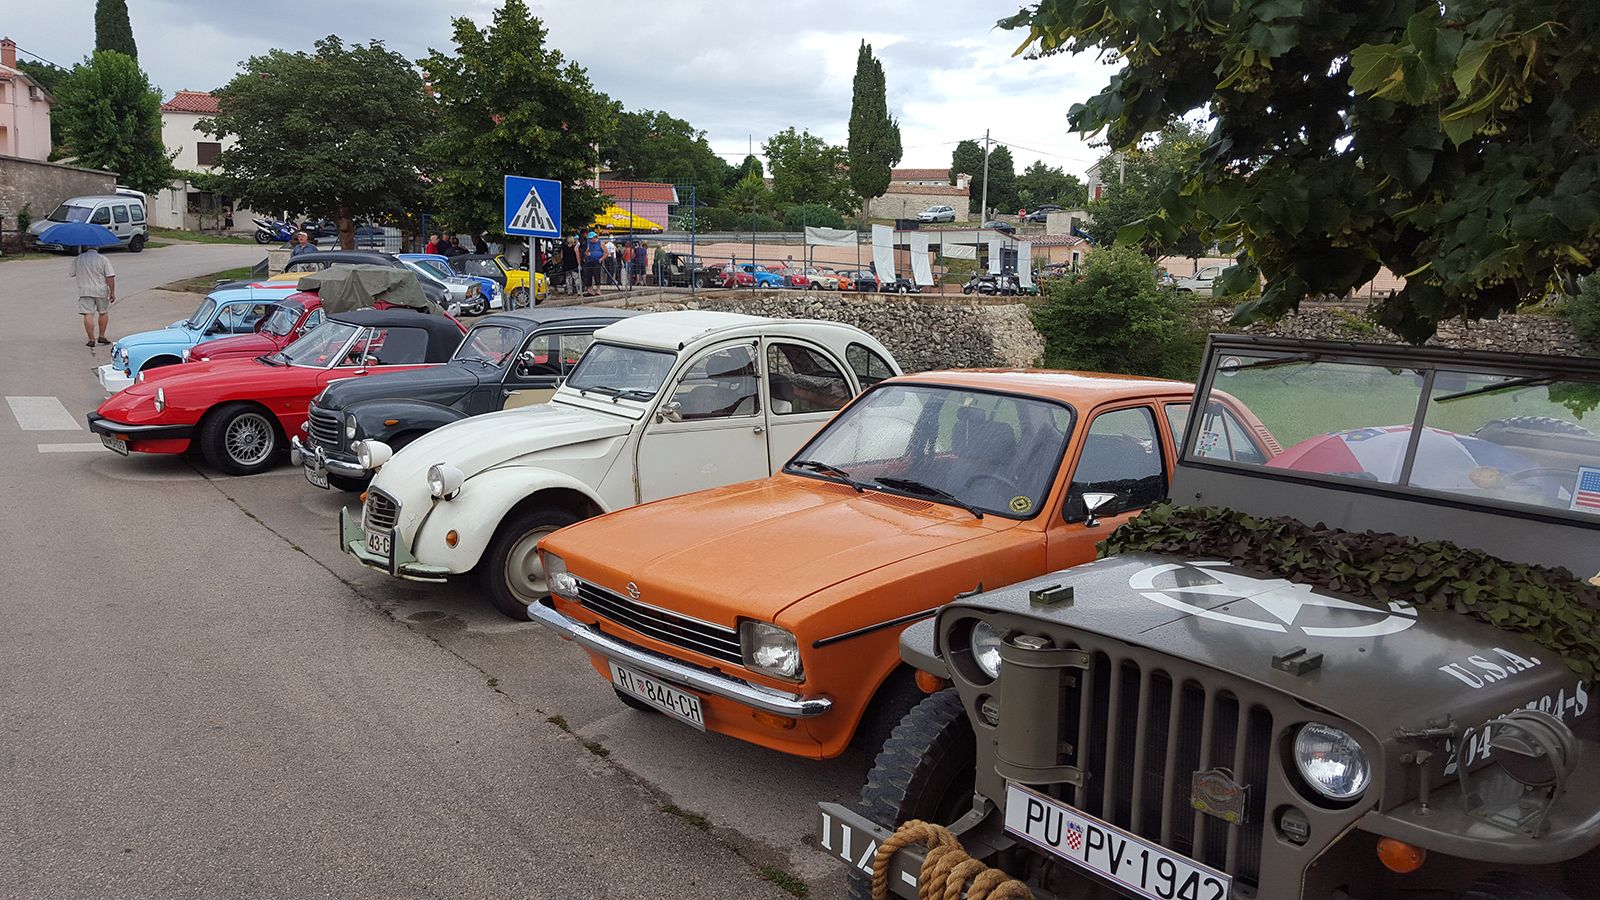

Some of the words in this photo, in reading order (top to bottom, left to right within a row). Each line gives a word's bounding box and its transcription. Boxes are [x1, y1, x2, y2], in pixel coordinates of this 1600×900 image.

[617, 667, 636, 692] RI
[645, 680, 701, 722] 844-CH
[1438, 647, 1542, 689] U.S.A.
[1025, 797, 1064, 848] PU
[1084, 824, 1224, 900] PV-1942
